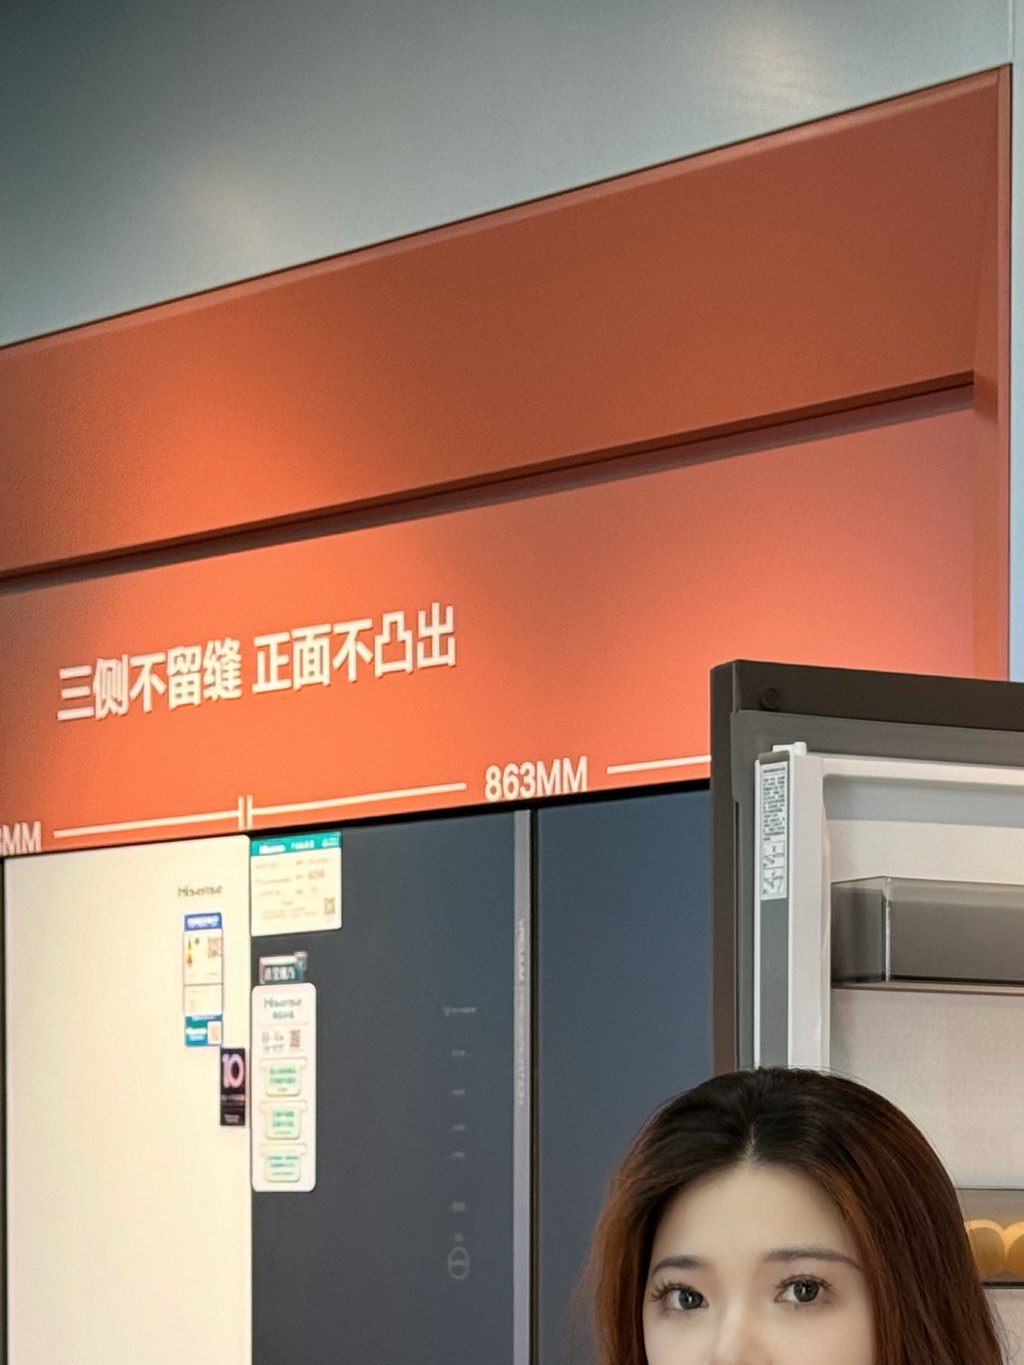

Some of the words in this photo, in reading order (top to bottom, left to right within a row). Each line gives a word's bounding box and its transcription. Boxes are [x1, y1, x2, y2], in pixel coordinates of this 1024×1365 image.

[57, 637, 242, 720] 三侧不留缝
[252, 602, 456, 694] 正面不凸出
[484, 756, 589, 802] 863MM
[0, 821, 42, 856] MM
[221, 1053, 244, 1089] 10
